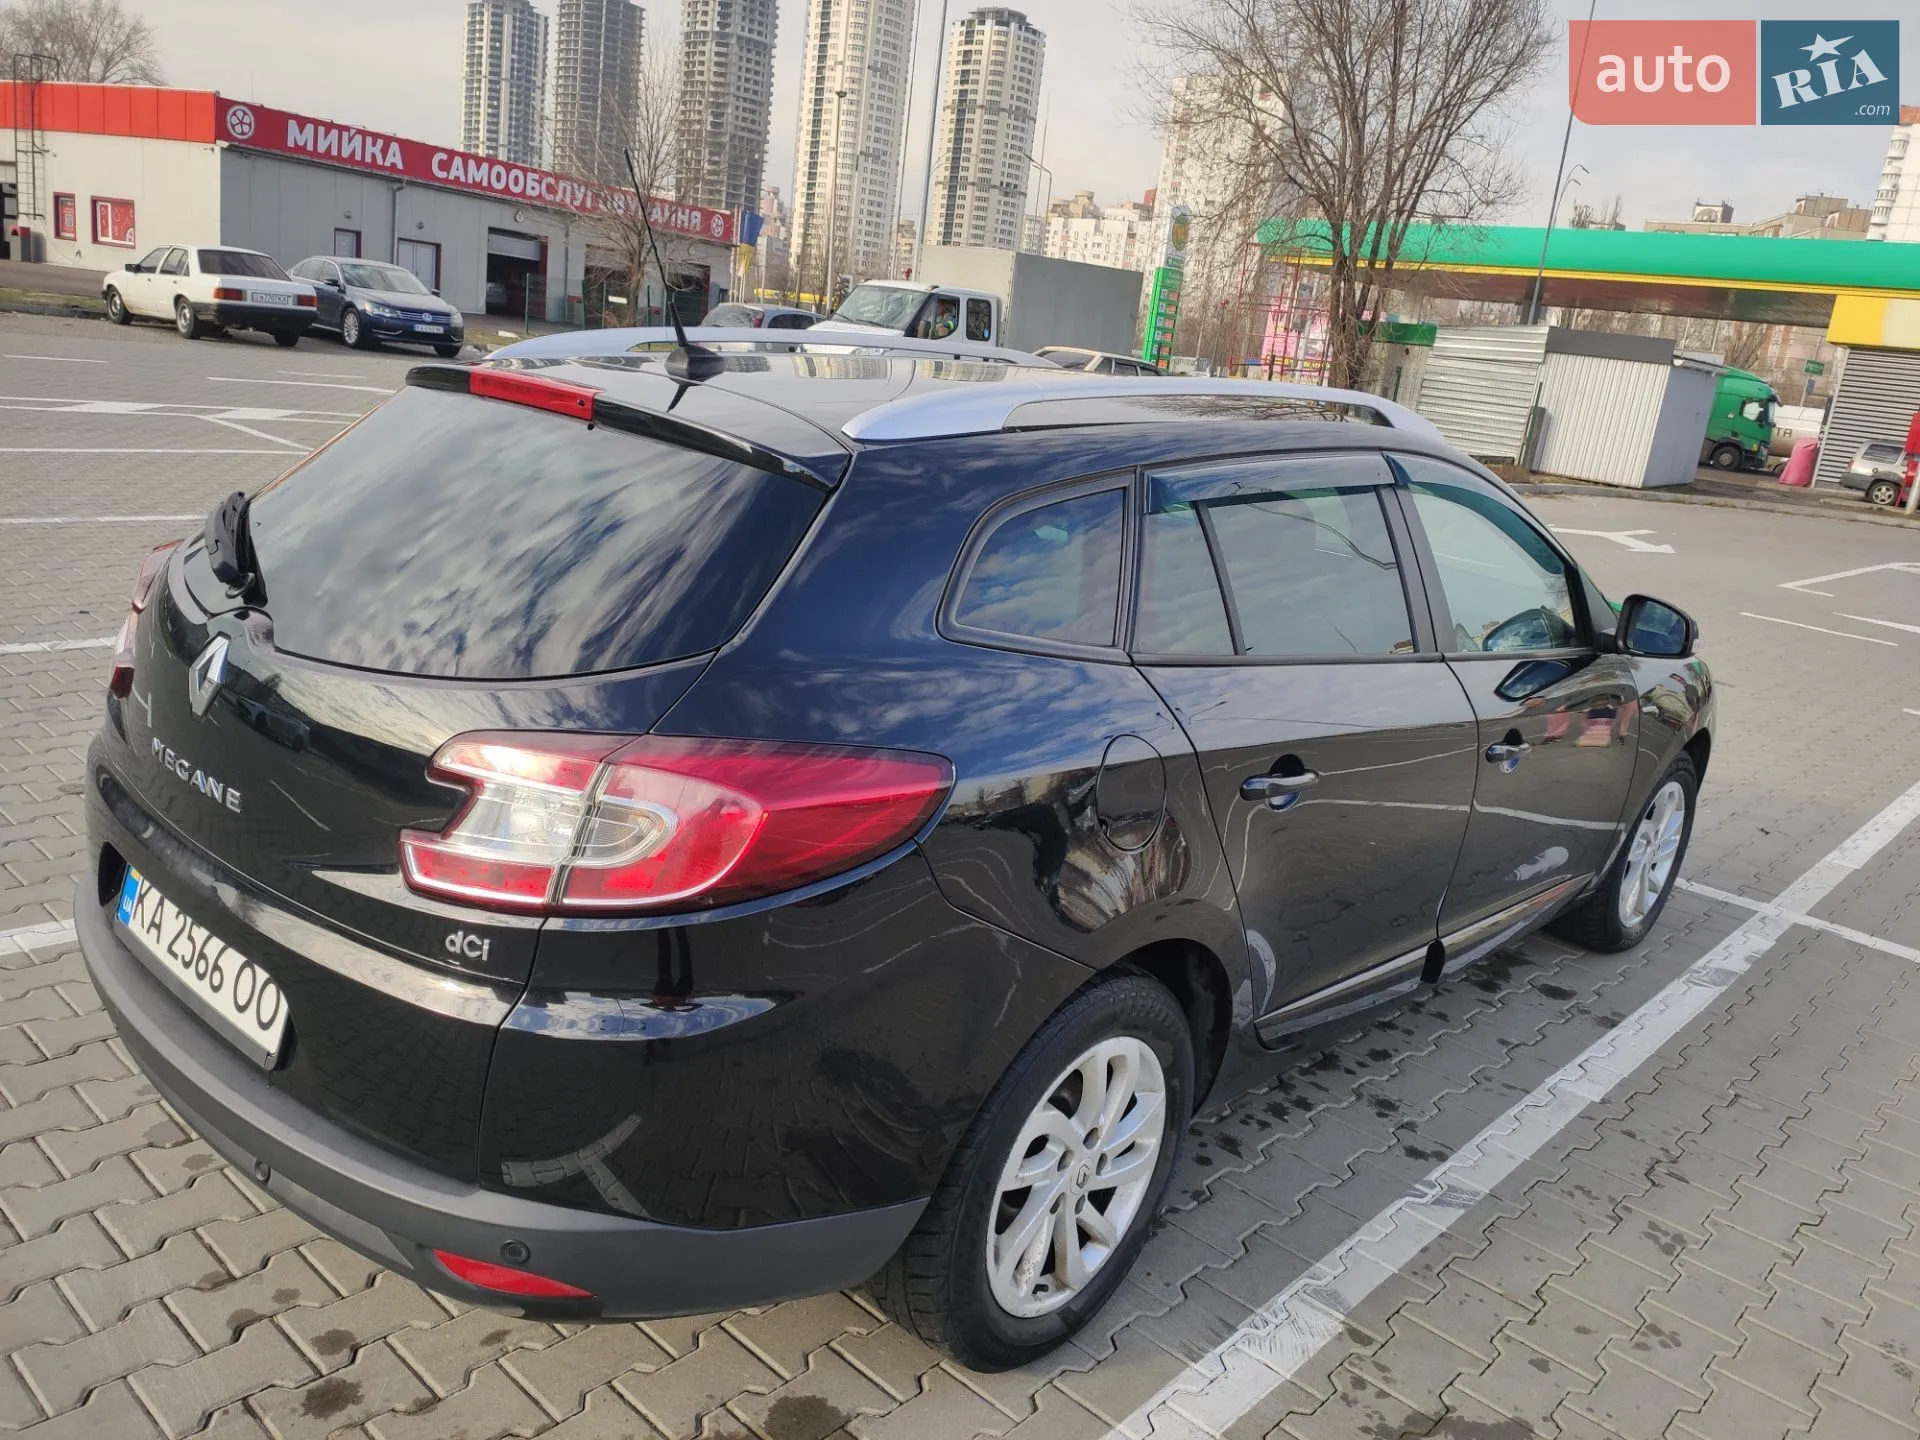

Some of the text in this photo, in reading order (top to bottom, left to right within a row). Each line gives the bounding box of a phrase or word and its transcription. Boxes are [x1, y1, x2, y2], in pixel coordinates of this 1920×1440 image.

[287, 119, 404, 170] МИЙКА
[151, 737, 243, 813] MEGANE
[123, 895, 133, 914] UA
[133, 877, 165, 945] KA
[167, 908, 231, 994] 2566
